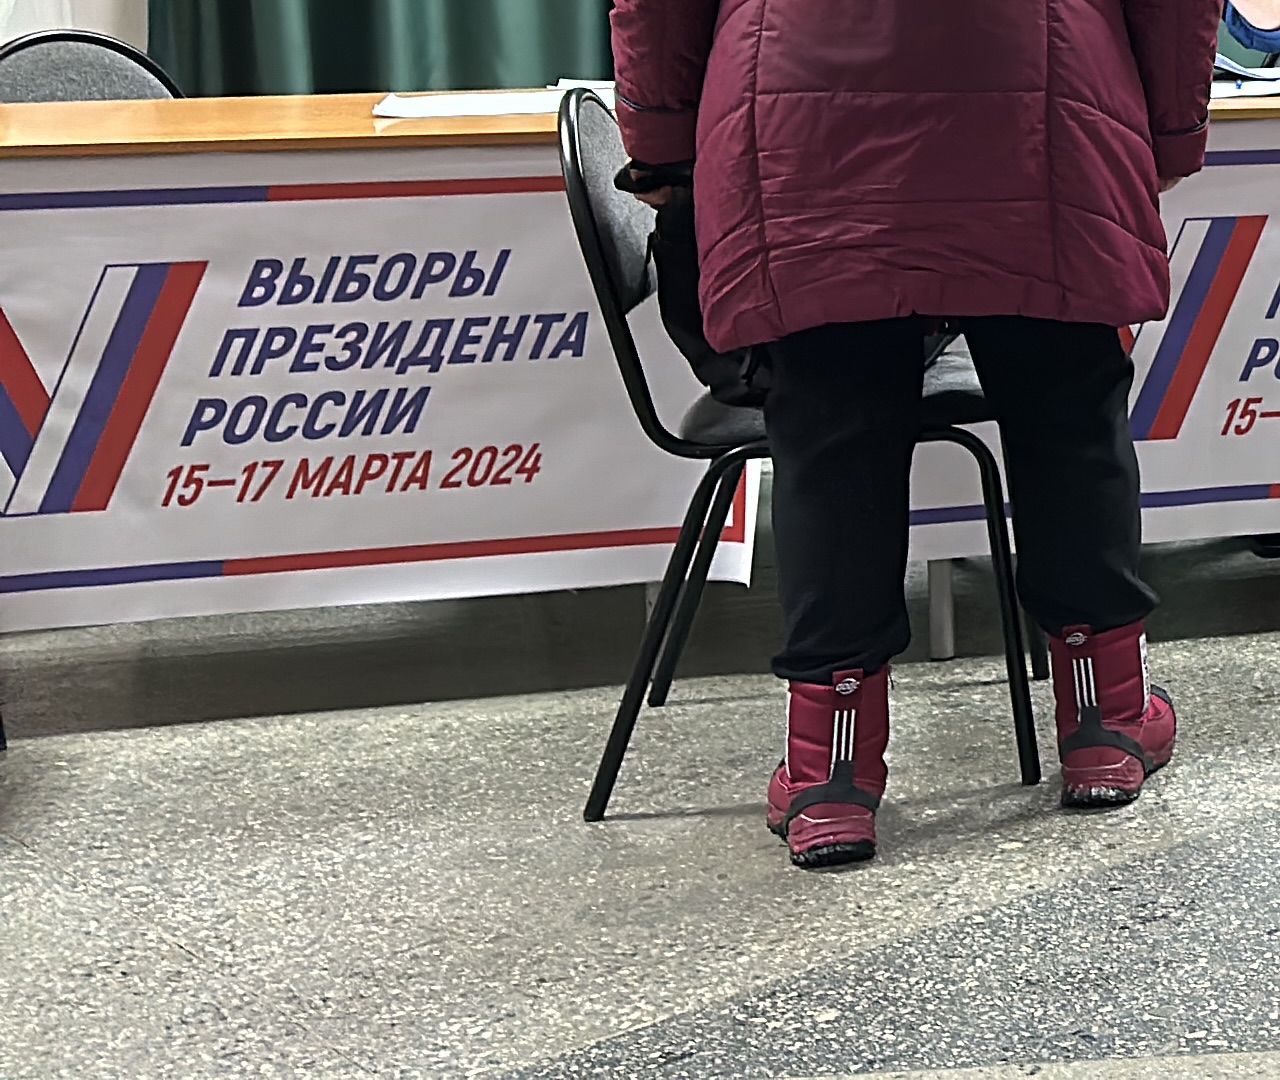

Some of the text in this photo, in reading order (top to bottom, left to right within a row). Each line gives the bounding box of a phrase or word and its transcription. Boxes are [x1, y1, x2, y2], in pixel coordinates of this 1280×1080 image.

[237, 249, 511, 308] ВЫБОРЫ
[208, 311, 590, 378] ПРЕЗИДЕНТА
[180, 385, 432, 448] РОССИИ
[286, 449, 434, 500] МАРТА
[439, 442, 544, 490] 2024
